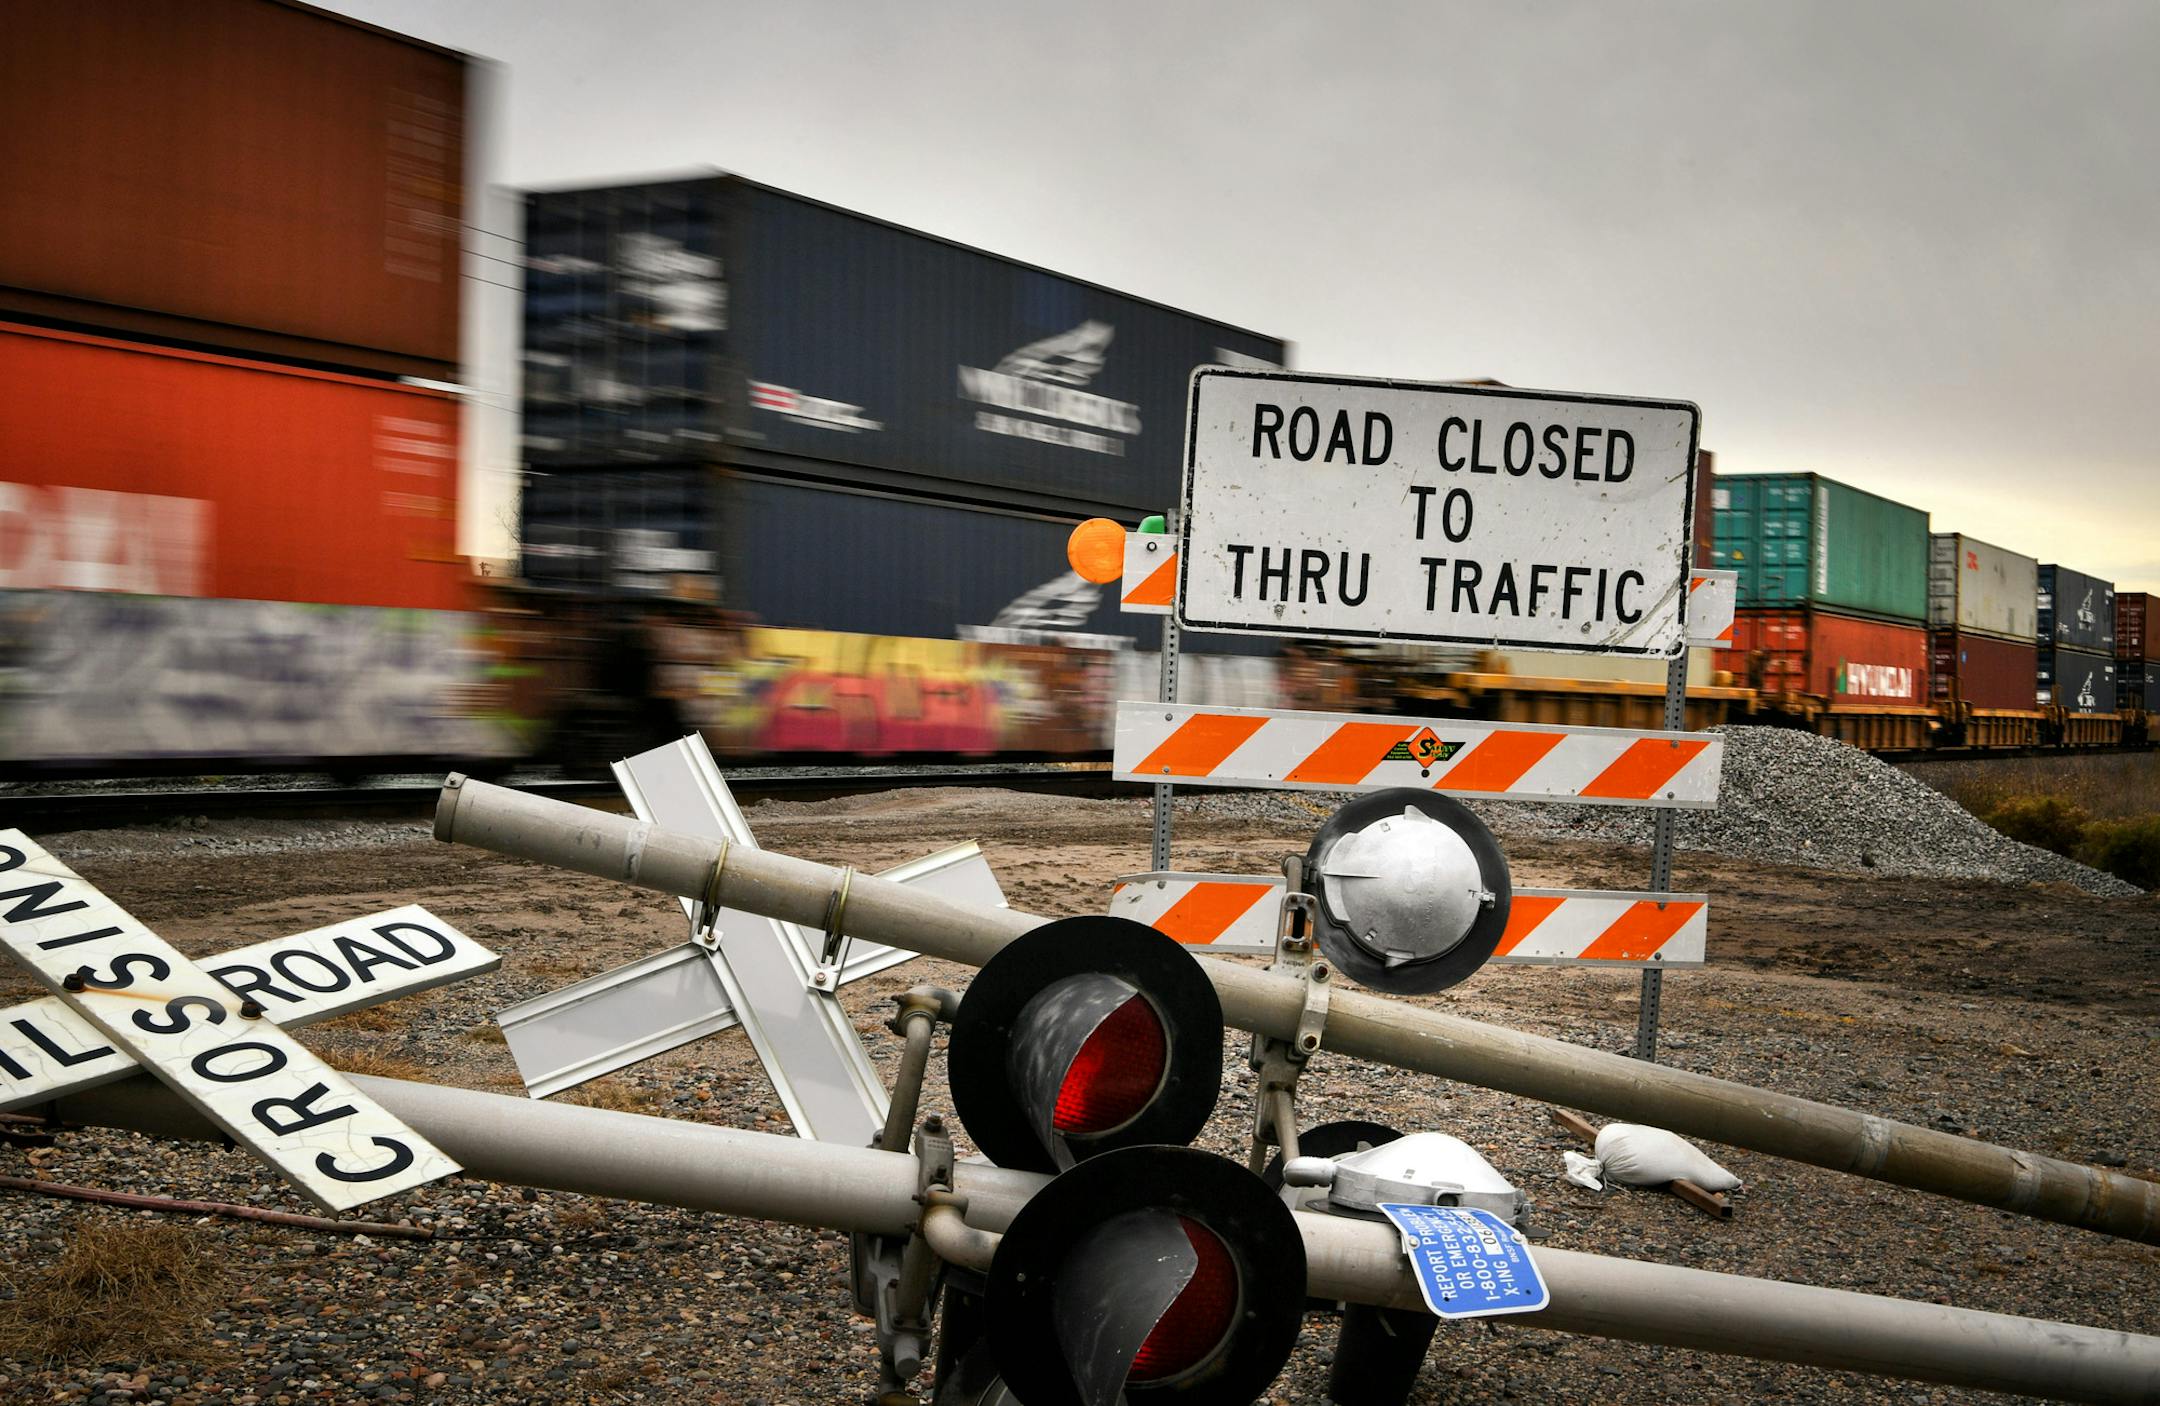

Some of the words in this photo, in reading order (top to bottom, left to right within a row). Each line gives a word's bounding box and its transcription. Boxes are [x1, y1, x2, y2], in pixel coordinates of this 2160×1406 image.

[1252, 403, 1393, 466] ROAD
[1438, 416, 1635, 483] CLOSED
[1410, 486, 1474, 543] TO
[1227, 544, 1370, 607] THRU
[1420, 557, 1646, 625] TRAFFIC
[0, 844, 414, 1183] CROSSIN
[1421, 1212, 1468, 1268] EMERGENCY
[1426, 1250, 1458, 1299] REPORT
[1456, 1271, 1475, 1289] OR
[1493, 1261, 1520, 1296] X-ING
